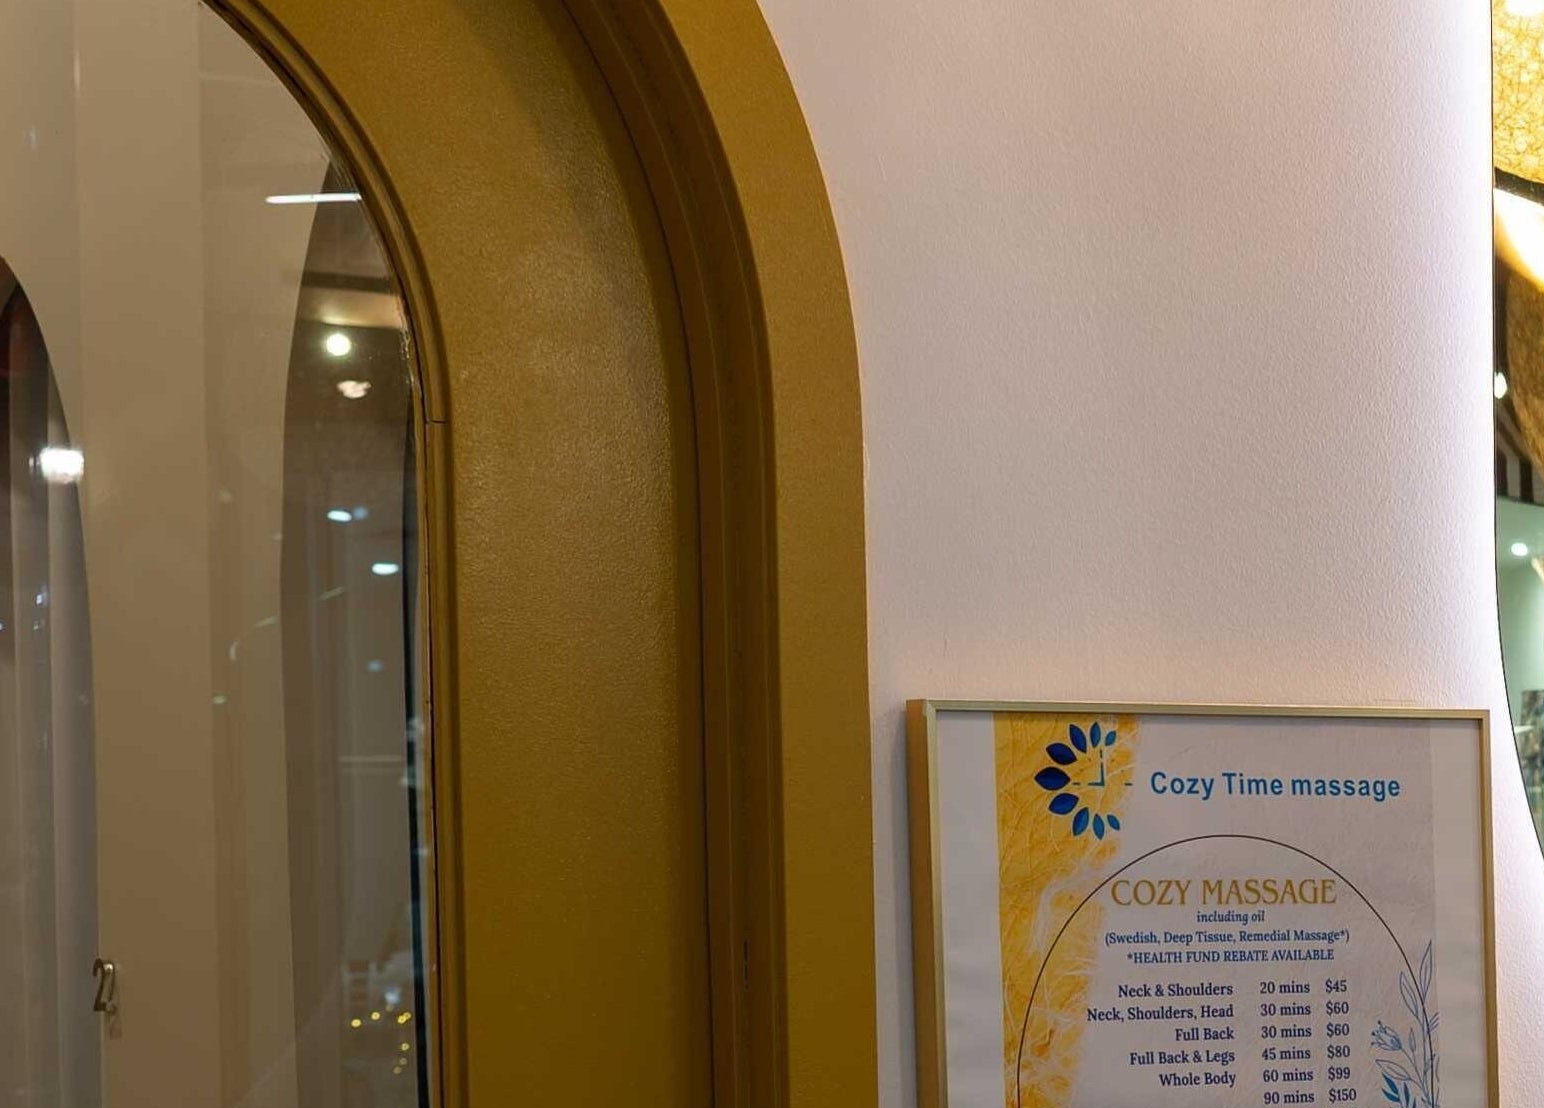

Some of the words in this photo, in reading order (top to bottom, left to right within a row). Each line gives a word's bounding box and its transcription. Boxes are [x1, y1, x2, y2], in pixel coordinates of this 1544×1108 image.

[1151, 771, 1214, 801] Cozy
[1222, 772, 1284, 796] Time
[1291, 778, 1400, 802] massage
[1111, 879, 1191, 906] COZY
[1202, 878, 1338, 906] MASSAGE
[1197, 910, 1249, 925] including
[1251, 910, 1265, 922] oil
[1105, 929, 1161, 946] (Swedish,
[1164, 931, 1193, 946] Deep
[1197, 930, 1236, 944] Tissue,
[1239, 930, 1291, 943] Remedial
[1186, 950, 1220, 963] FUND
[1224, 949, 1269, 963] REBATE
[1271, 948, 1335, 962] AVAILABLE
[1118, 984, 1151, 998] Neck
[1154, 985, 1164, 996] &
[1168, 983, 1233, 997] Shoulders
[1260, 981, 1275, 994] 20
[1279, 981, 1310, 994] mins
[1326, 979, 1347, 994] $45
[1087, 1008, 1124, 1022] Neck,
[1127, 1006, 1197, 1020] Shoulders,
[1200, 1004, 1234, 1018] Head
[1261, 1004, 1276, 1016] 30
[1280, 1004, 1311, 1016] mins
[1326, 1001, 1349, 1015] $60
[1175, 1027, 1199, 1041] Full
[1203, 1026, 1234, 1040] Back
[1261, 1025, 1277, 1038] 30
[1281, 1026, 1312, 1038] mins
[1326, 1023, 1350, 1038] $60
[1130, 1051, 1154, 1065] Full
[1158, 1050, 1189, 1064] Back
[1193, 1050, 1202, 1063] &
[1206, 1049, 1235, 1065] Legs
[1262, 1047, 1277, 1061] 45
[1279, 1048, 1311, 1060] mins
[1327, 1045, 1350, 1059] $80
[1159, 1072, 1200, 1087] Whole
[1205, 1072, 1236, 1087] Body
[1263, 1069, 1278, 1082] 60
[1282, 1070, 1313, 1081] mins
[1328, 1066, 1350, 1081] $99
[1264, 1091, 1279, 1104] 90
[1284, 1091, 1314, 1103] mins
[1329, 1088, 1356, 1103] $150
